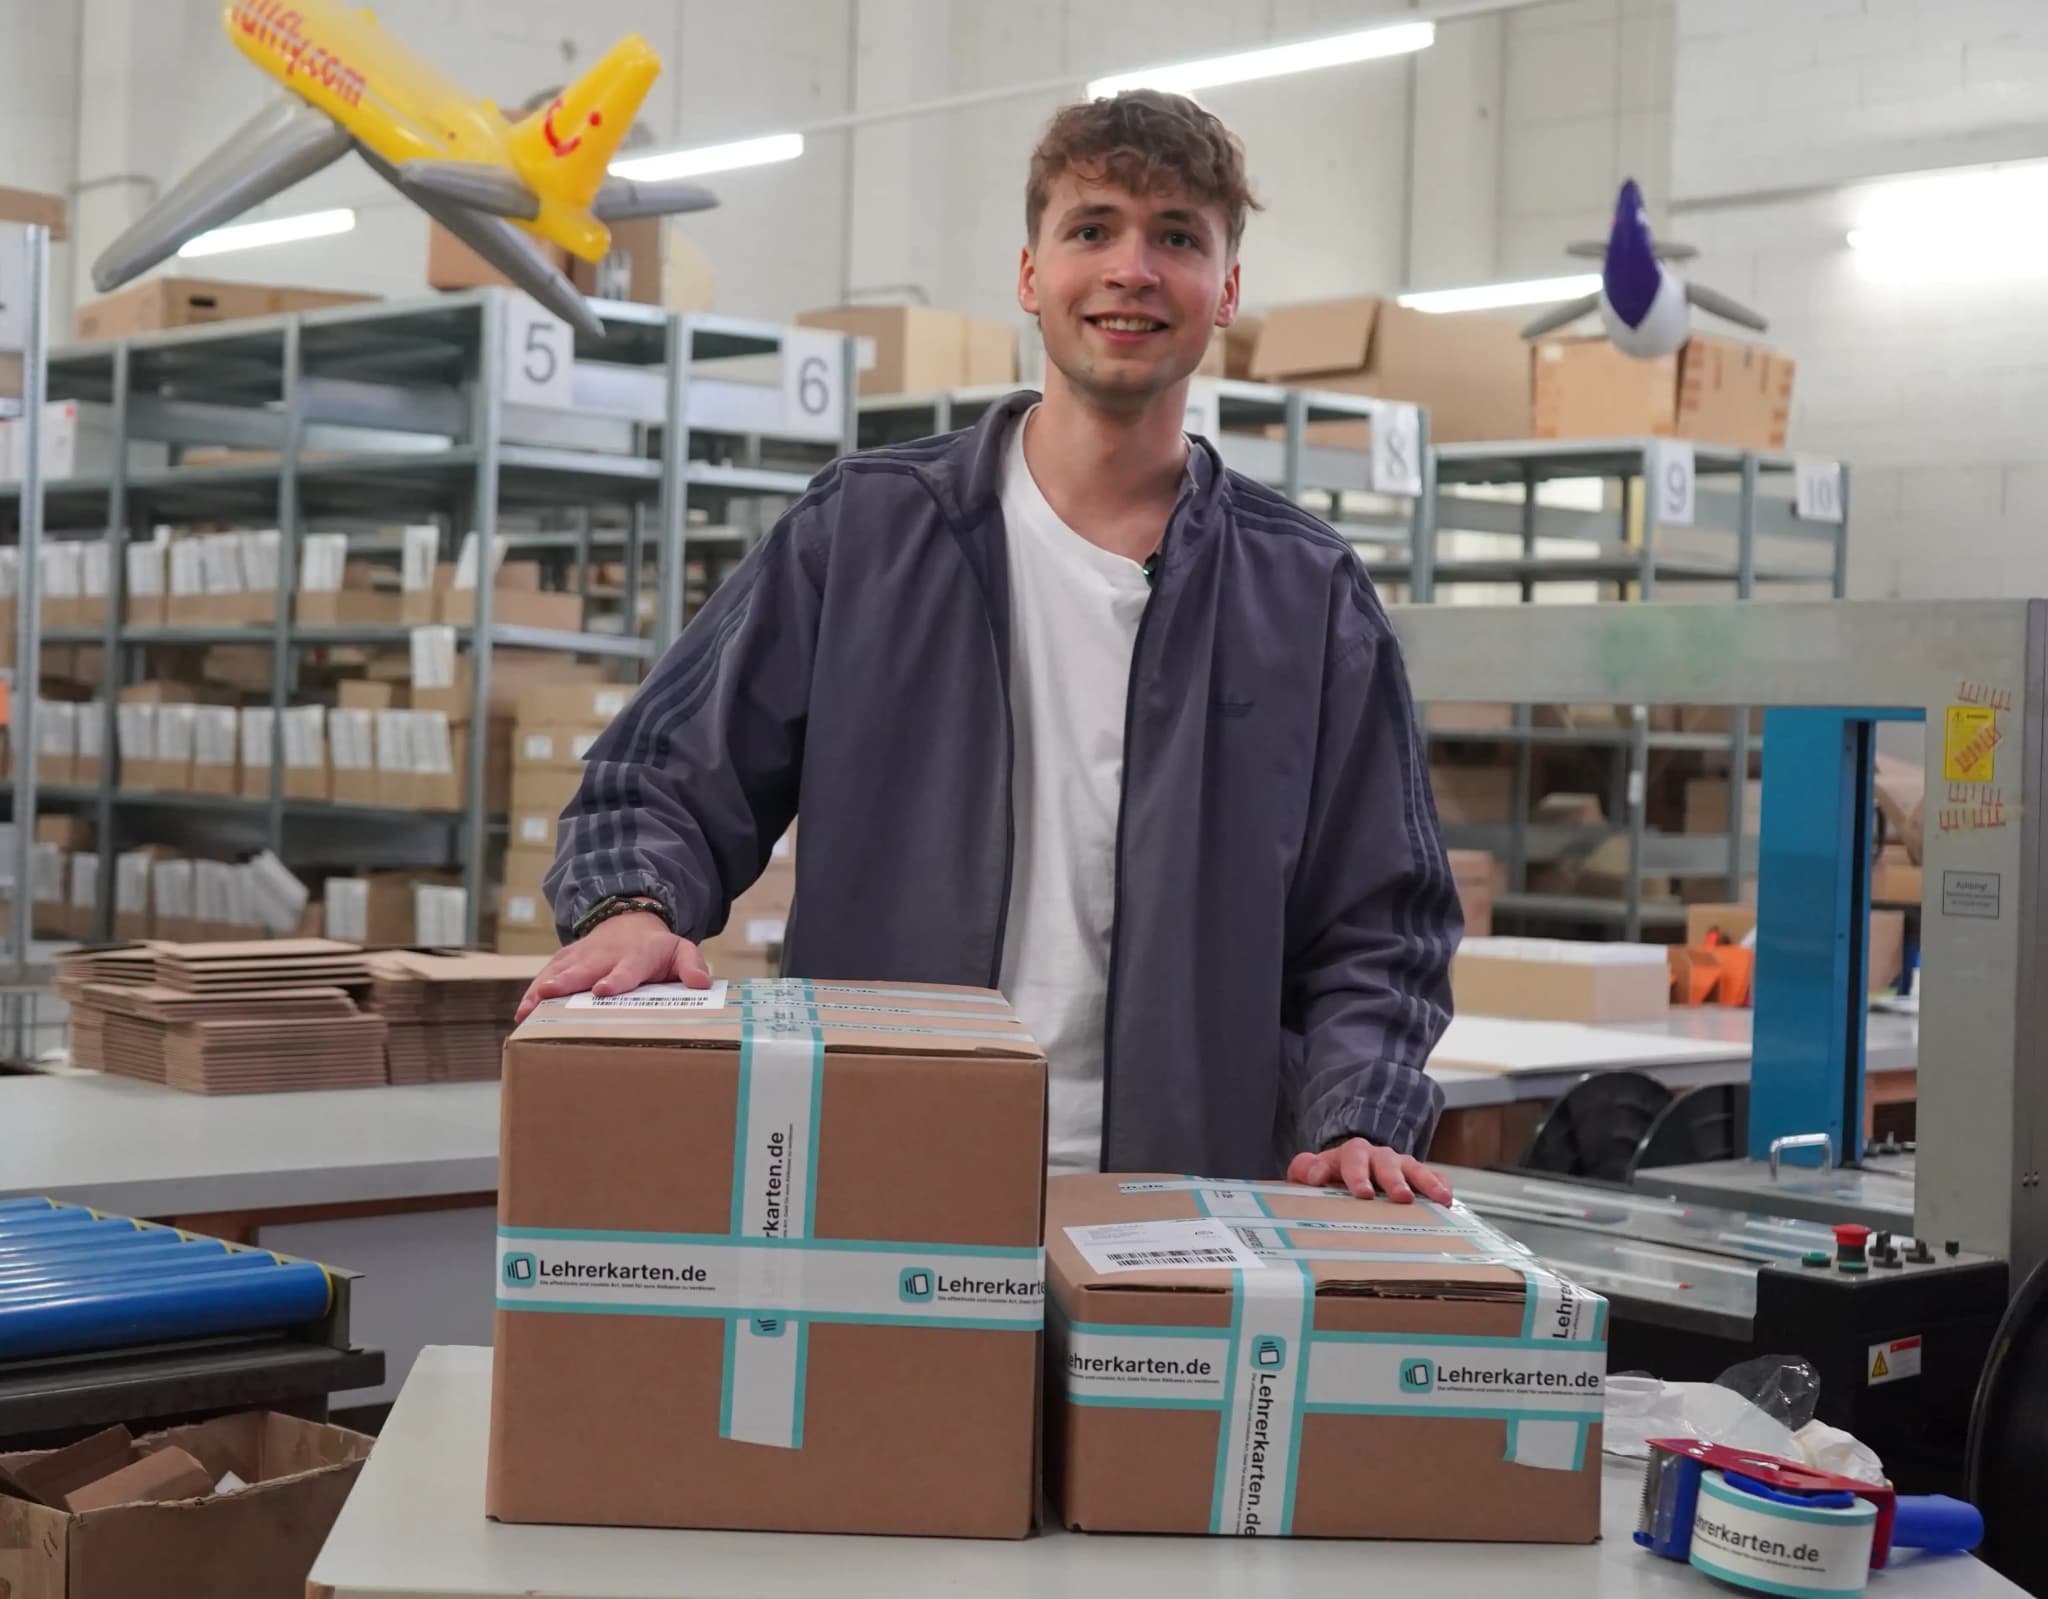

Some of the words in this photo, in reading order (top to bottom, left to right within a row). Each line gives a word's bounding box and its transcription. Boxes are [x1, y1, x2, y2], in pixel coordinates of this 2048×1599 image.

[523, 322, 557, 384] 5
[799, 355, 830, 416] 6
[1385, 426, 1409, 478] 8
[1667, 462, 1688, 515] 9
[1806, 475, 1834, 515] 10
[539, 1260, 707, 1282] Lehrerkarten.de
[1437, 1366, 1599, 1388] Lehrerkarten.de
[1244, 1373, 1277, 1535] Lehrerkarten.de
